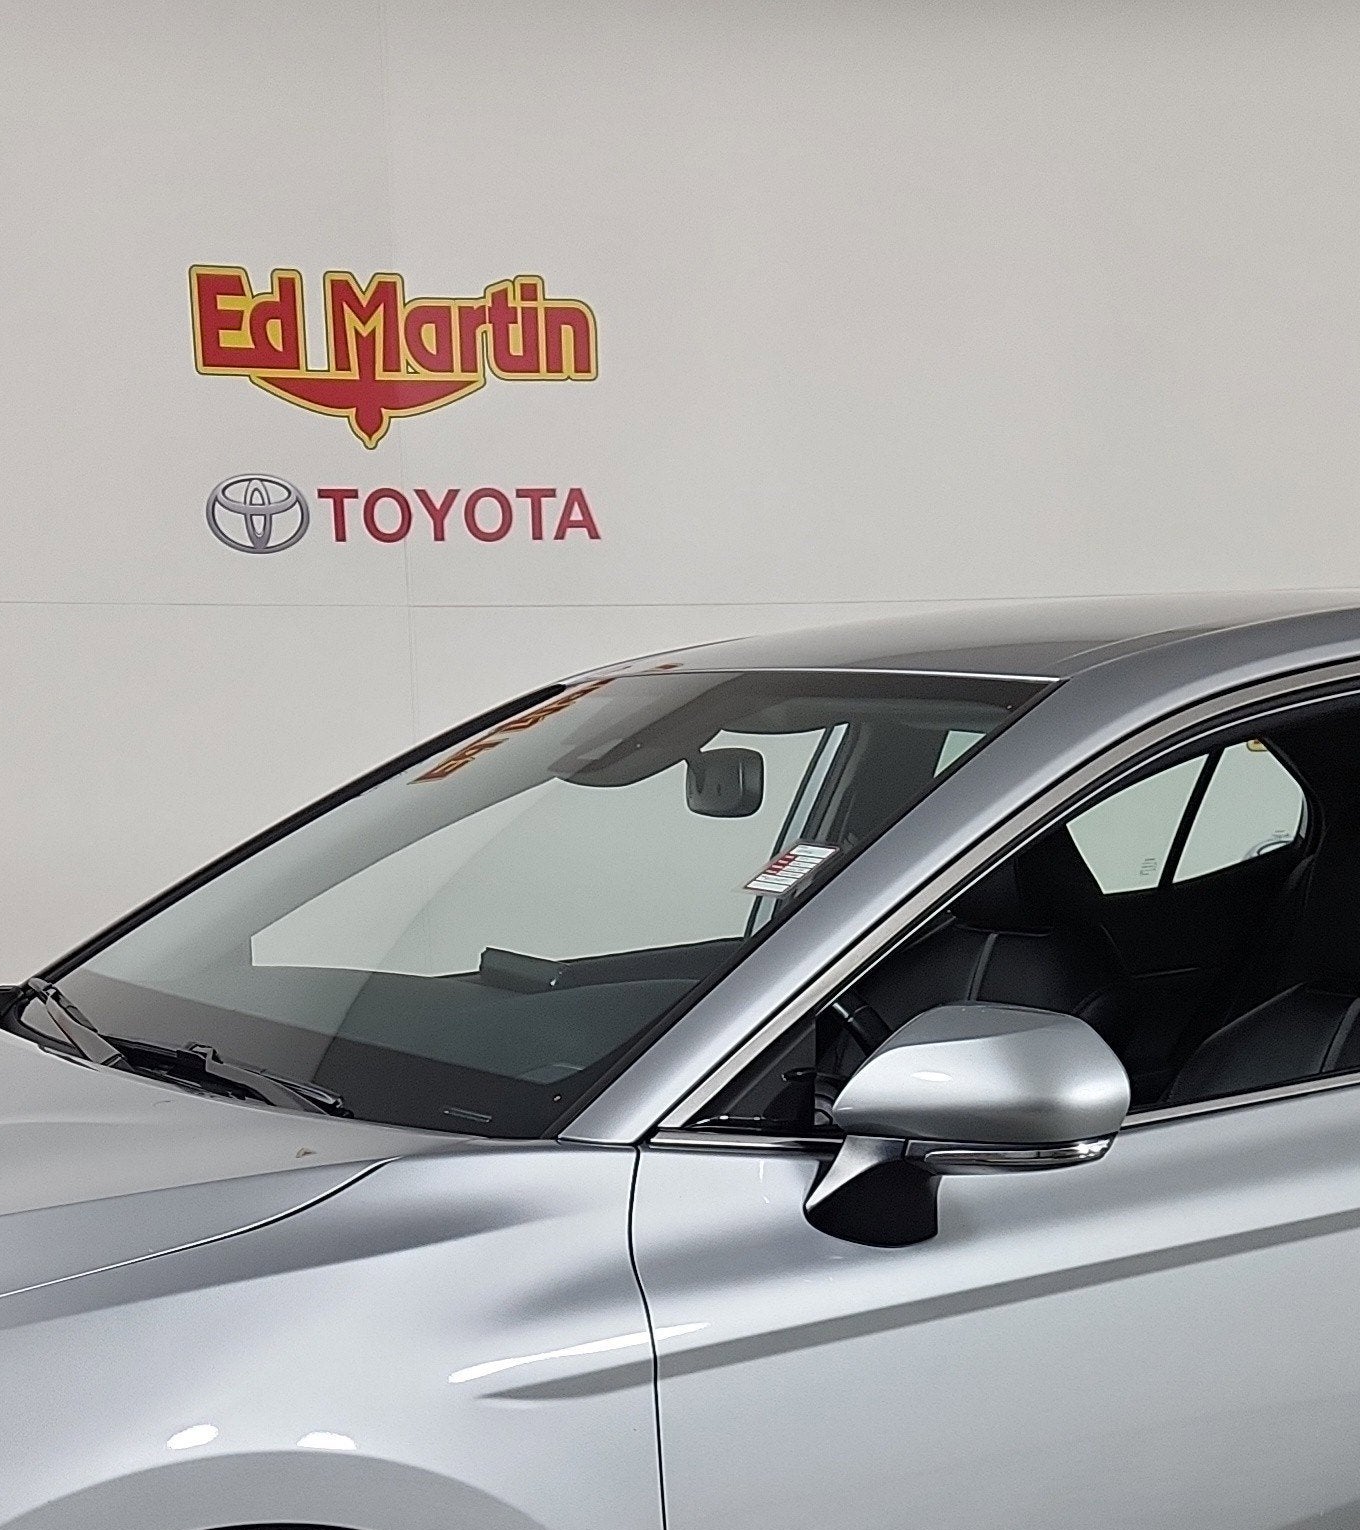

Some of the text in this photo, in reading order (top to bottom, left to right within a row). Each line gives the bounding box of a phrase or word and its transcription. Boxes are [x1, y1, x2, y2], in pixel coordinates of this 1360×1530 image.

[194, 272, 595, 374] Ed Martin
[317, 486, 602, 543] TOYOTA
